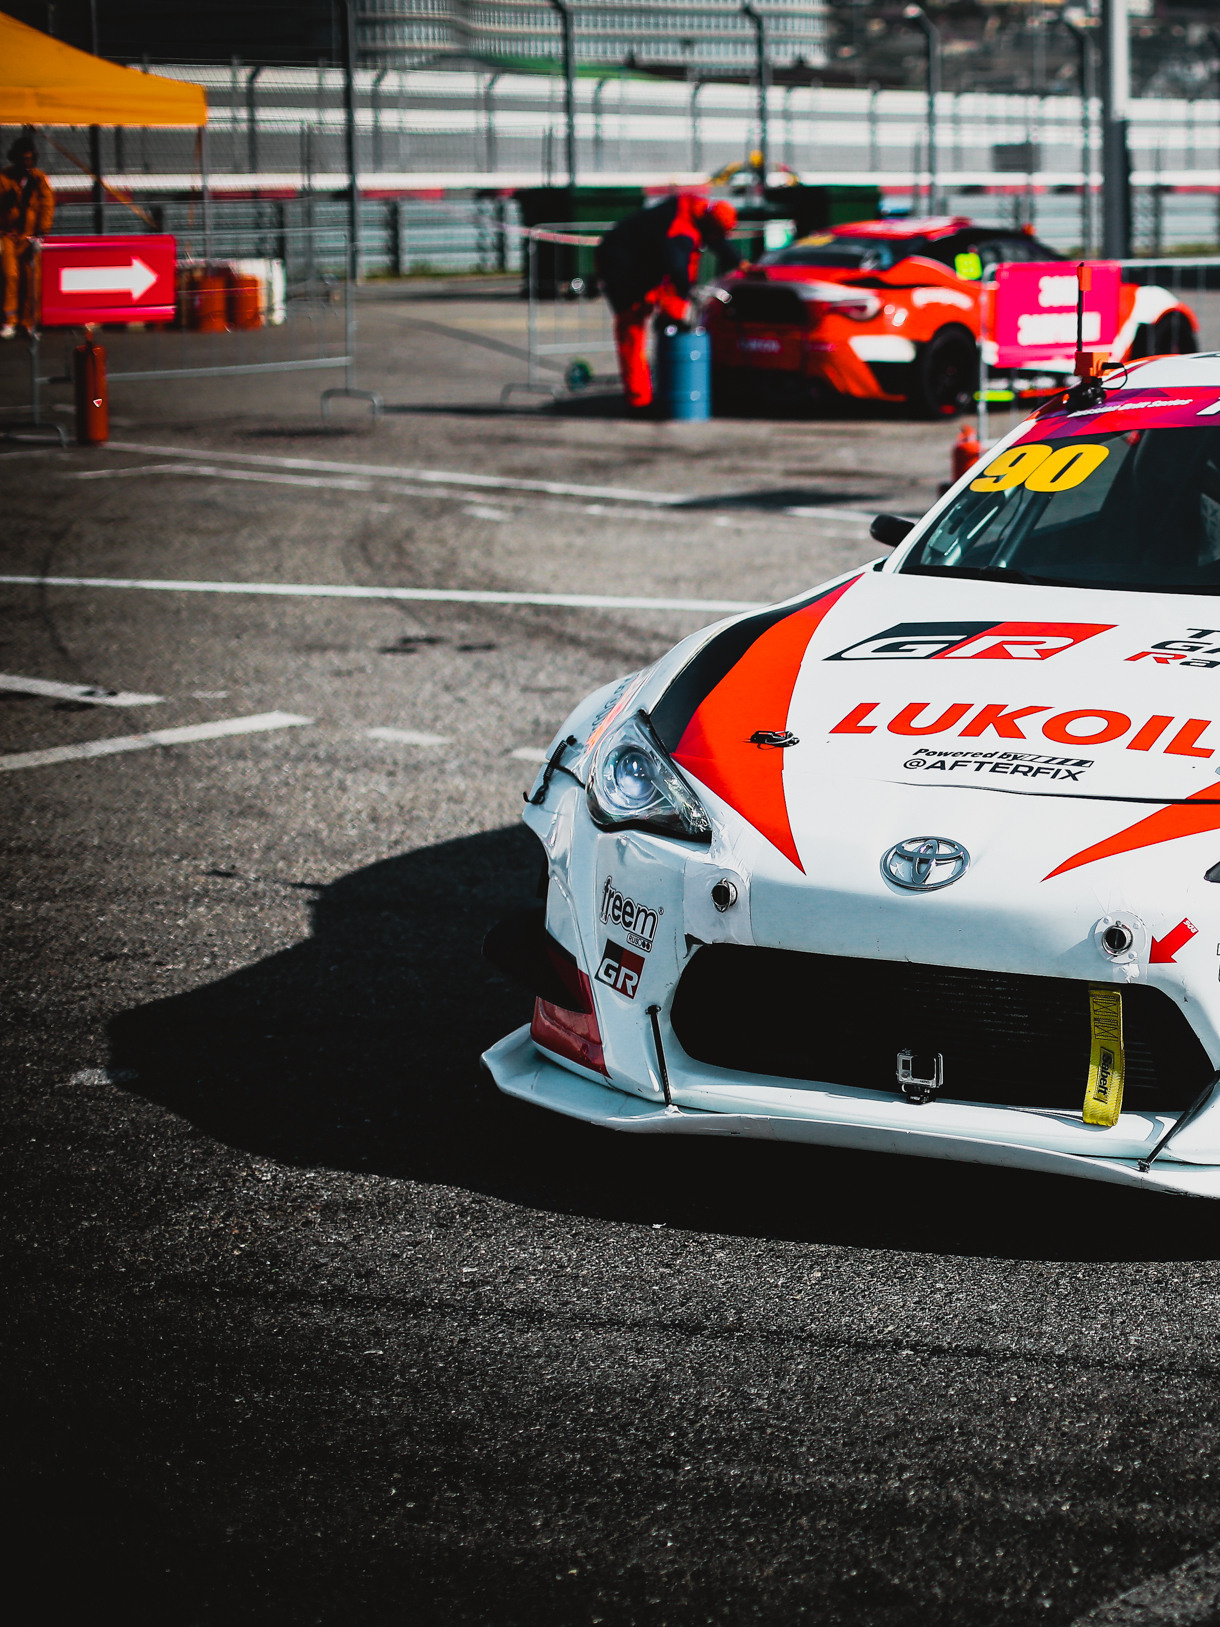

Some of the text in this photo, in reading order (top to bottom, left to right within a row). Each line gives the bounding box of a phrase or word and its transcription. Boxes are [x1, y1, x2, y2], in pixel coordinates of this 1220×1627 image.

[970, 444, 1110, 492] 90
[841, 635, 1075, 660] GR
[829, 702, 1216, 758] LUKOIL
[903, 758, 1086, 781] @AFTERFIX
[912, 748, 1023, 761] Powered by
[601, 877, 657, 939] freem
[598, 957, 639, 997] GR
